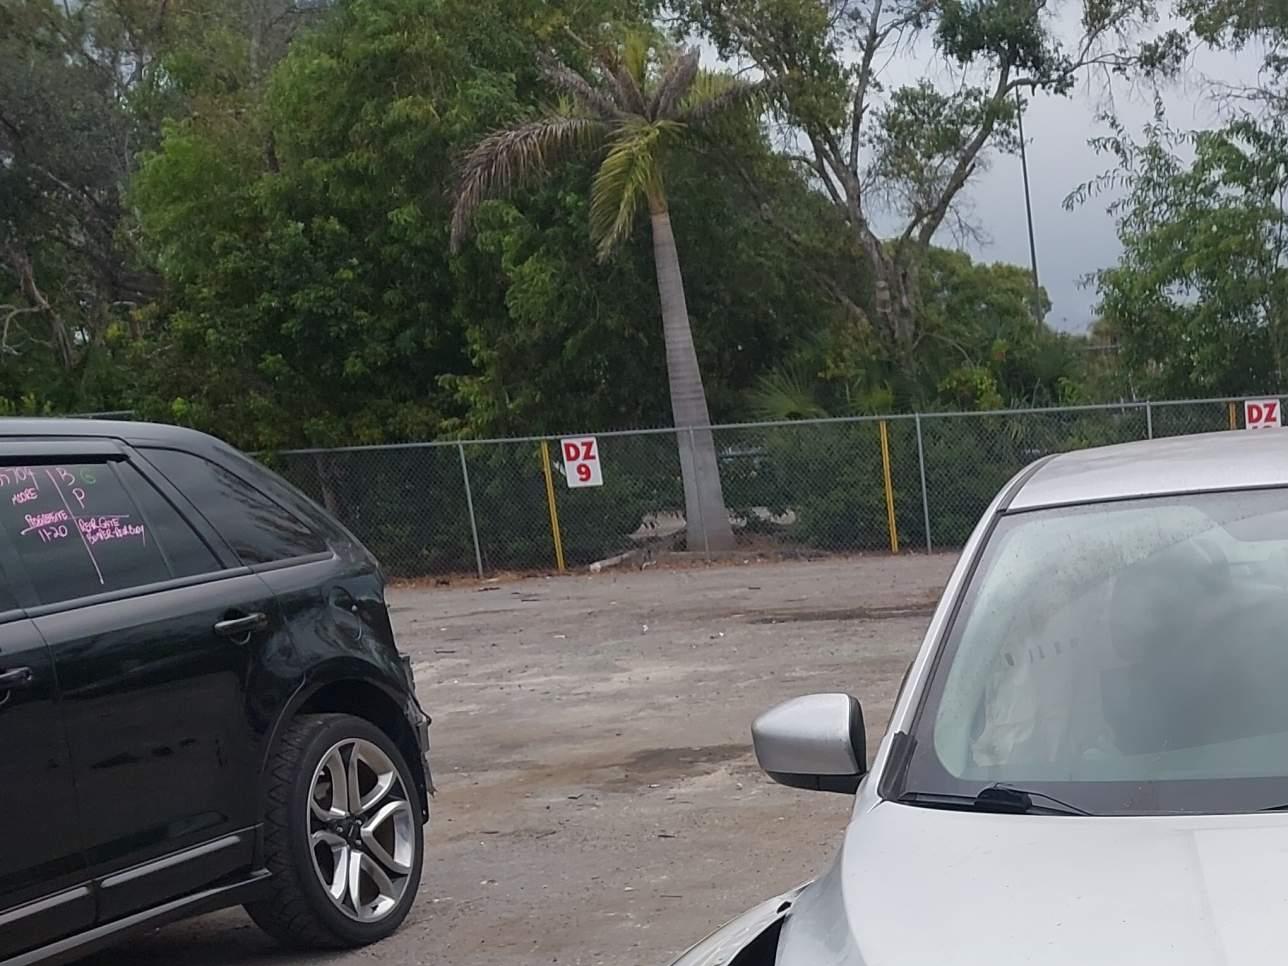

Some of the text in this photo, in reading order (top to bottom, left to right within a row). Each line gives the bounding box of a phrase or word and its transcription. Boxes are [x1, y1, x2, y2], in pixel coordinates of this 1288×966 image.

[1247, 402, 1277, 423] DZ
[564, 441, 596, 461] DZ
[576, 464, 591, 481] 9
[72, 488, 85, 509] P
